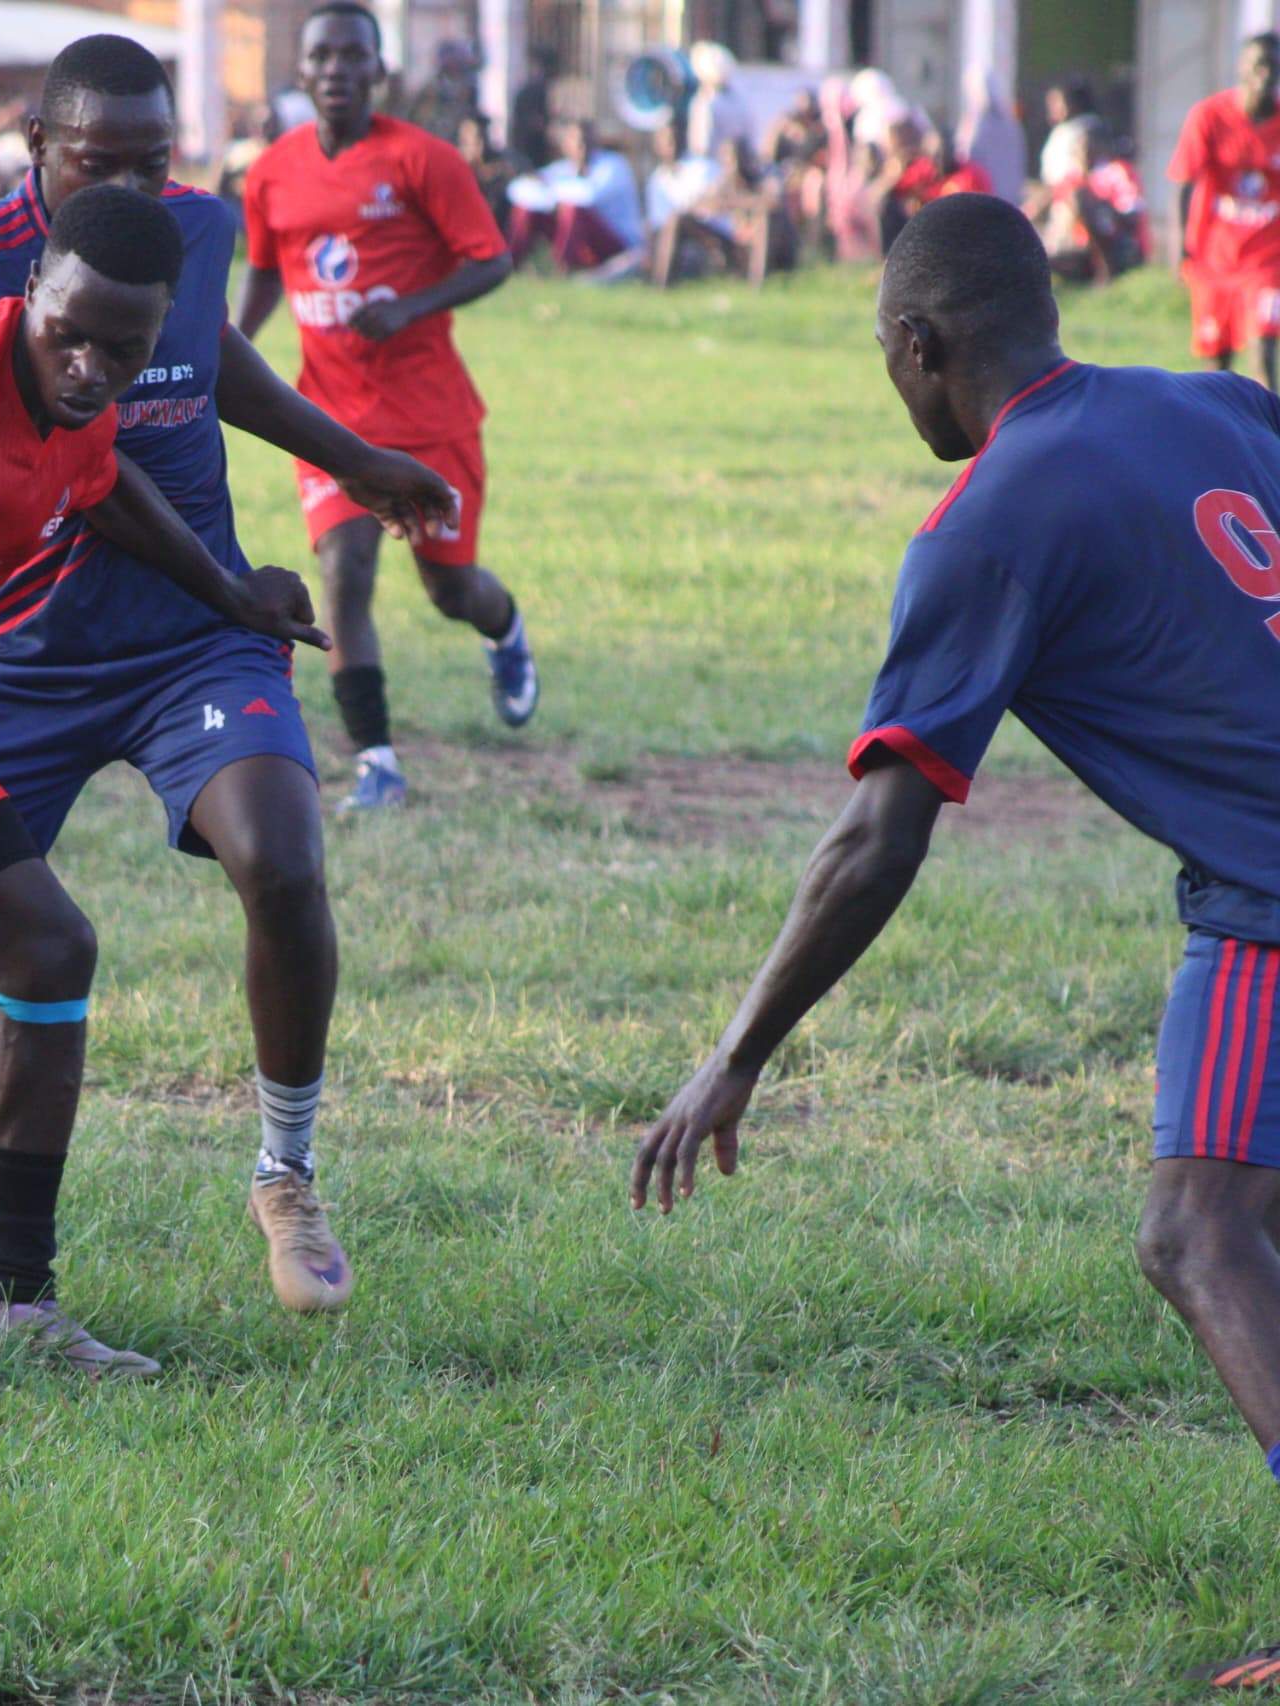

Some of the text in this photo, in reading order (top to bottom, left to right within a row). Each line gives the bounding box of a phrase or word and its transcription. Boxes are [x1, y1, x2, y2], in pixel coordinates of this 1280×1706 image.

[134, 364, 194, 384] TED BY:
[203, 704, 225, 731] 4
